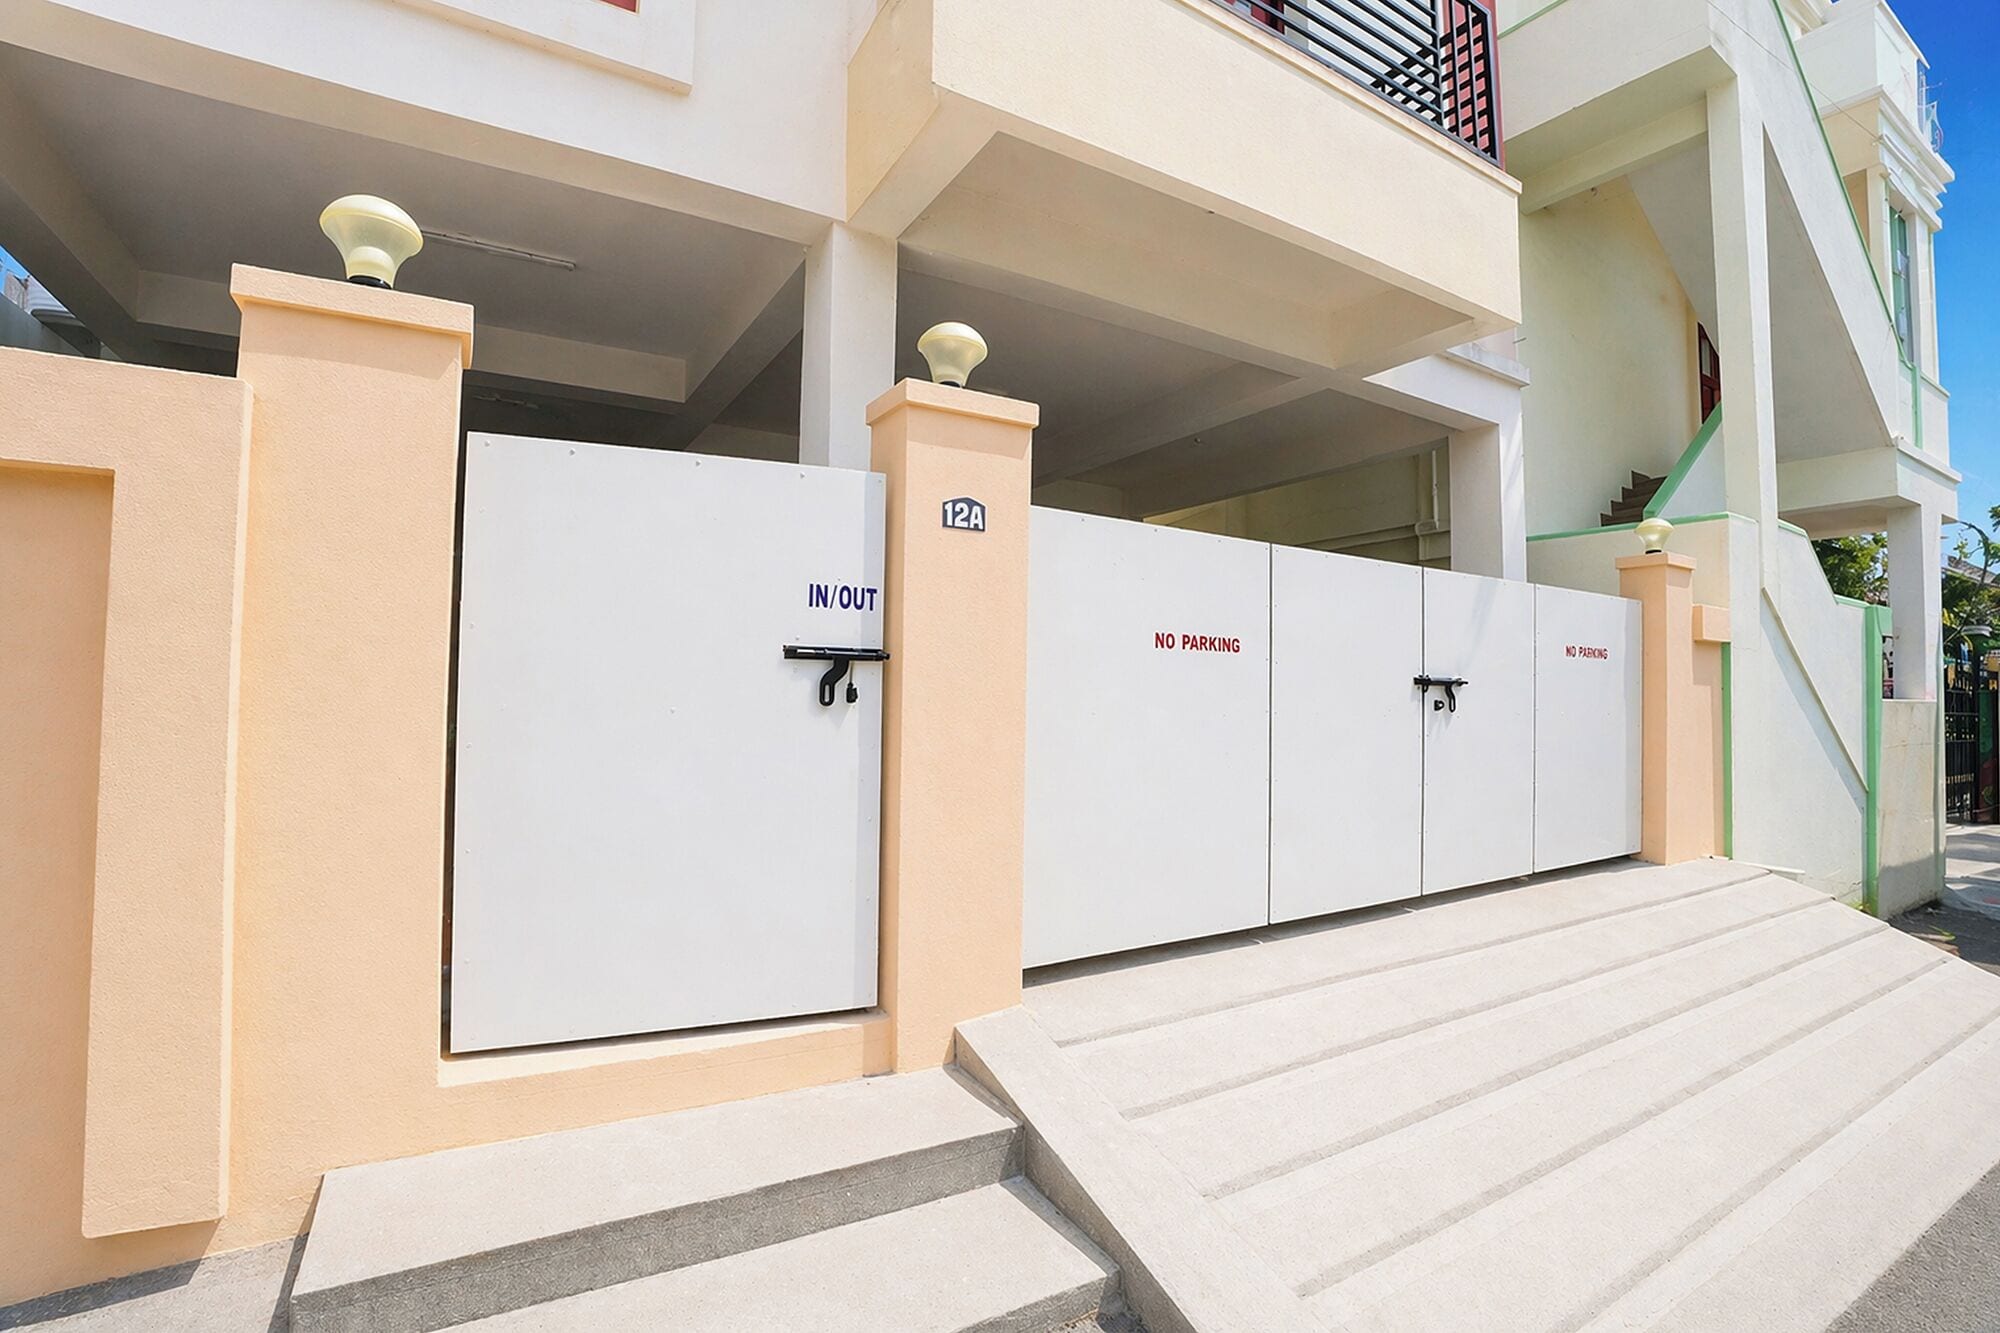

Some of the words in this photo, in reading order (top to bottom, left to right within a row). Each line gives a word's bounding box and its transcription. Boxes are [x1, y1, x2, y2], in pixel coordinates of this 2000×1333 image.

[944, 501, 984, 530] 12A
[808, 583, 878, 611] IN/OUT
[1154, 632, 1176, 649] NO
[1182, 633, 1241, 653] PARKING
[1565, 645, 1577, 658] NO
